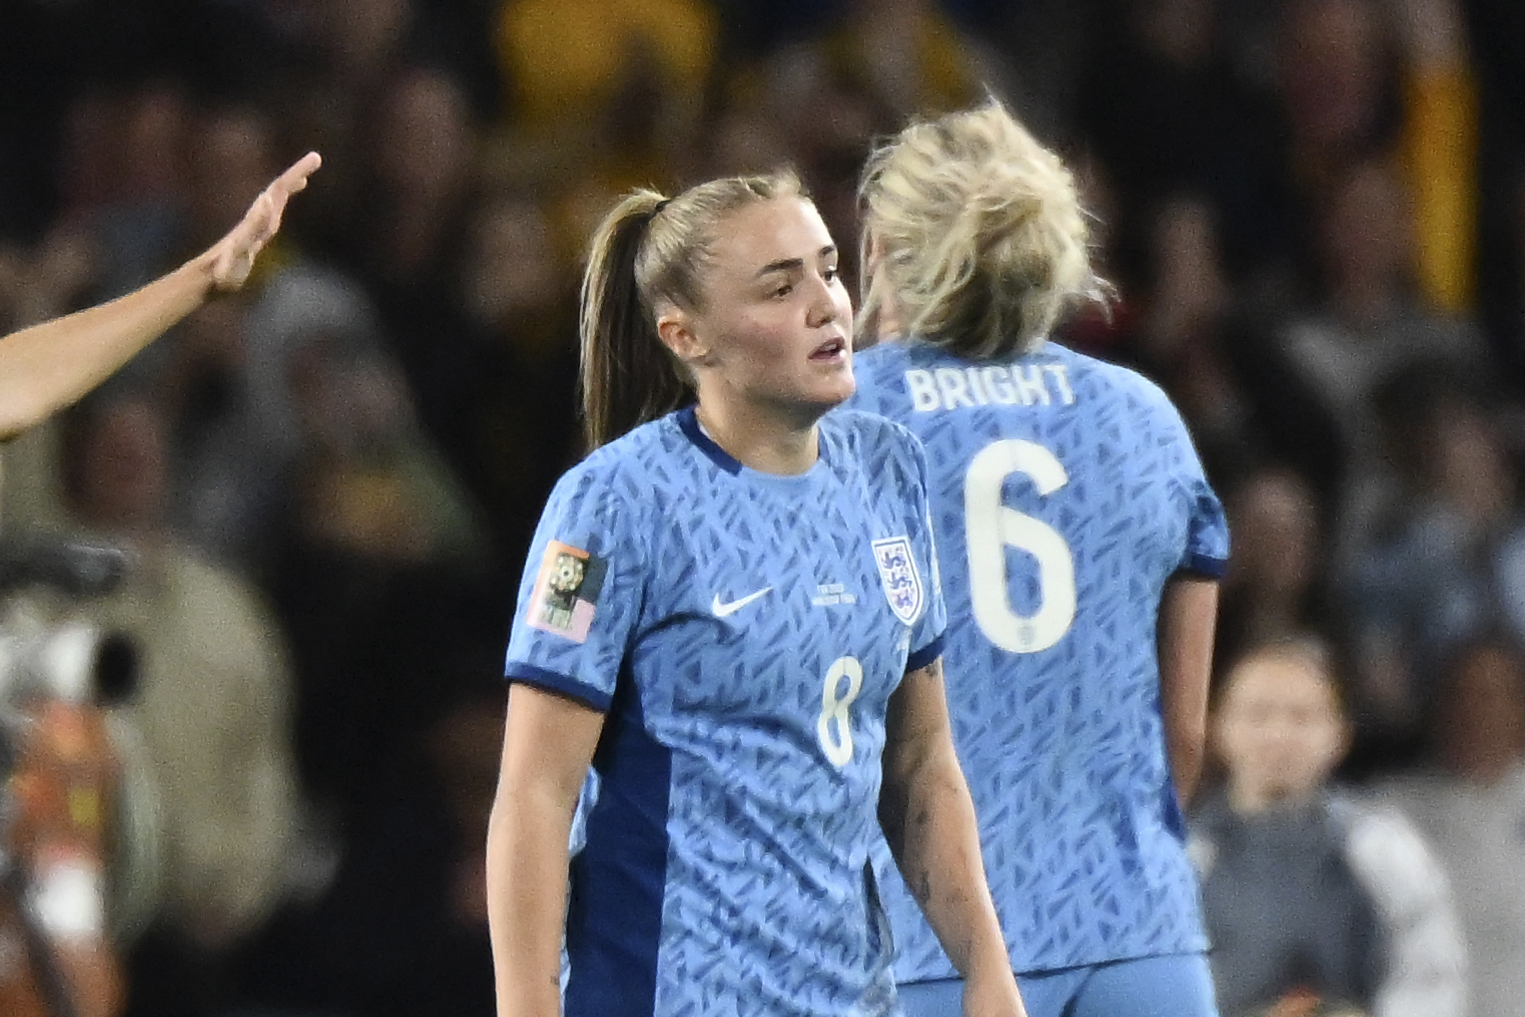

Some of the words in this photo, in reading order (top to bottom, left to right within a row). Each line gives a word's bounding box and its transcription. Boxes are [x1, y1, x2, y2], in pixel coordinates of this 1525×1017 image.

[905, 364, 1074, 412] BRIGHT
[964, 438, 1077, 653] 6
[818, 655, 863, 766] 8
